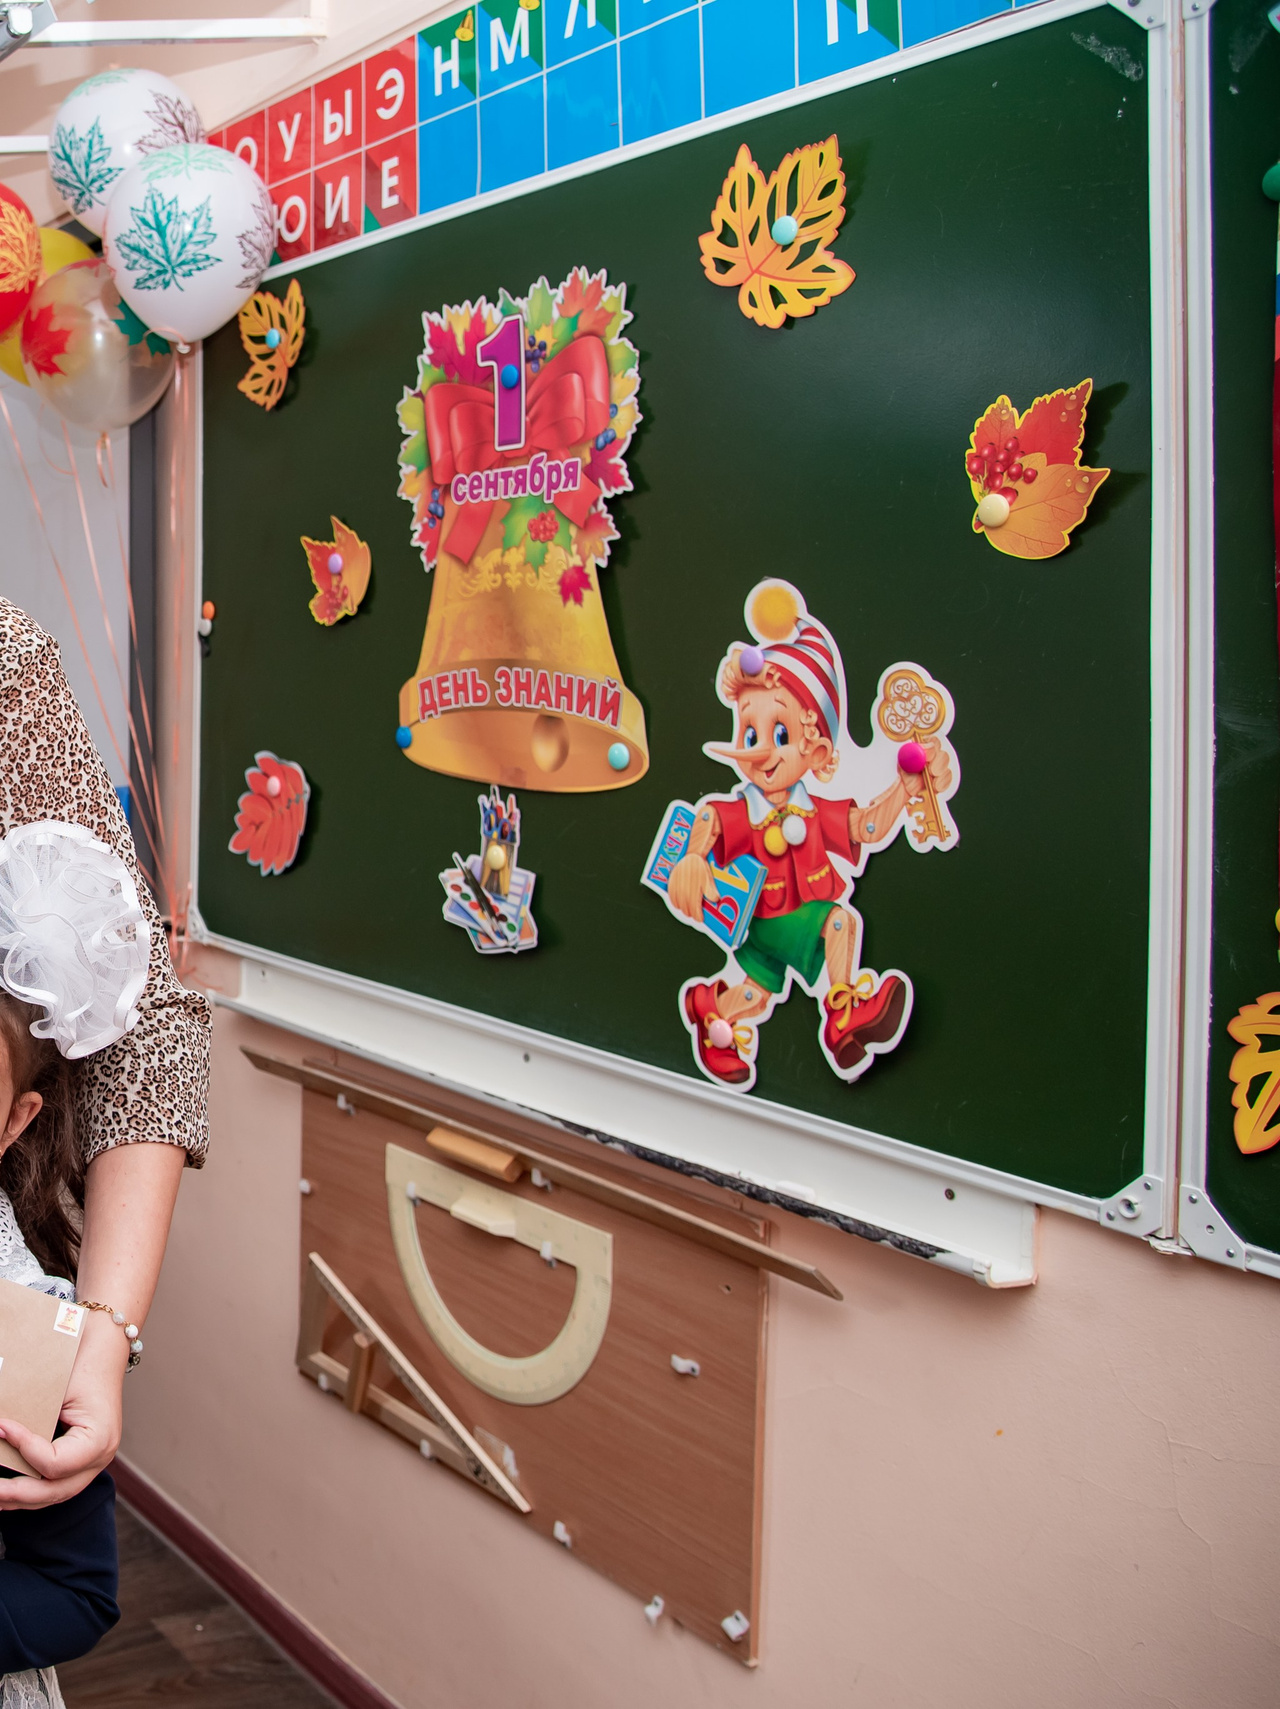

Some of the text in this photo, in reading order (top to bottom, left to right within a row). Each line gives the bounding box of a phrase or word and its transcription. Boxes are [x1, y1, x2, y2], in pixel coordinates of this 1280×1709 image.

[277, 112, 302, 163] У
[323, 88, 352, 145] Ы
[375, 68, 405, 120] Э
[434, 38, 460, 97] Н
[489, 6, 530, 72] М
[325, 175, 349, 229] И
[381, 156, 400, 209] Е
[477, 314, 524, 450] 1
[452, 453, 580, 502] сентября
[418, 667, 622, 728] ДЕНЬ ЗНАНИЙ
[651, 812, 692, 884] АЗБУКА
